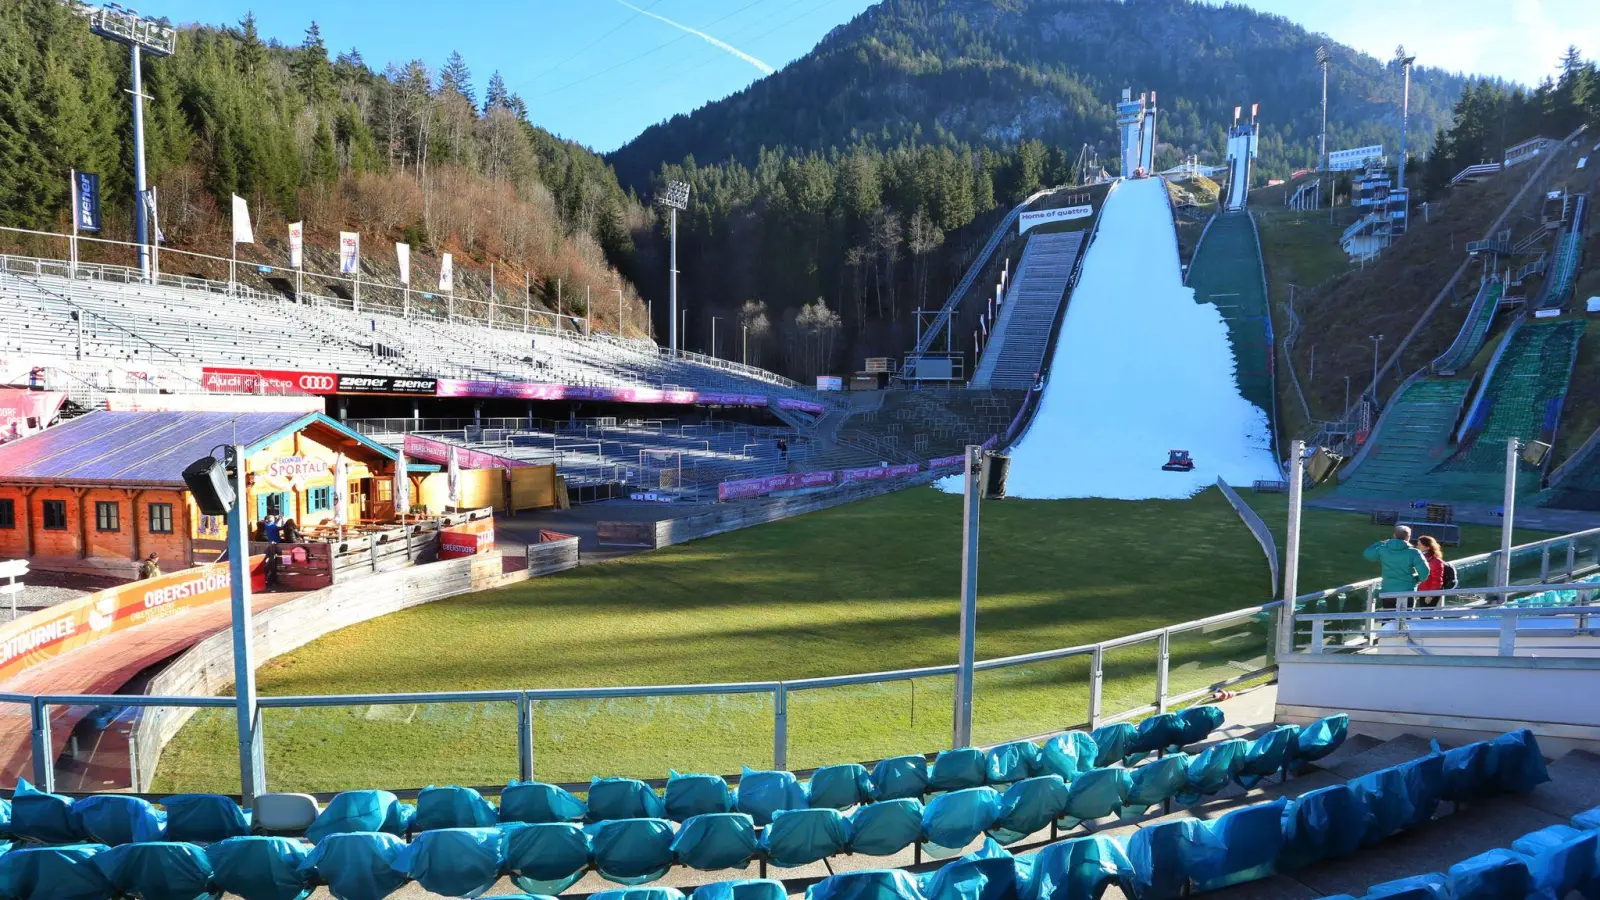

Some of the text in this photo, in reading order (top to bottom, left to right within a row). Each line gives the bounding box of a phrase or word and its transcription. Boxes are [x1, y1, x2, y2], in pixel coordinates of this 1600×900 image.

[81, 174, 93, 226] ziener
[1021, 212, 1045, 220] Home
[1057, 208, 1089, 217] quattro
[207, 375, 241, 386] Audi
[340, 377, 387, 387] ziener
[393, 379, 435, 389] ziener
[270, 462, 328, 477] SPORTALP
[442, 543, 476, 553] OBERSTDORF
